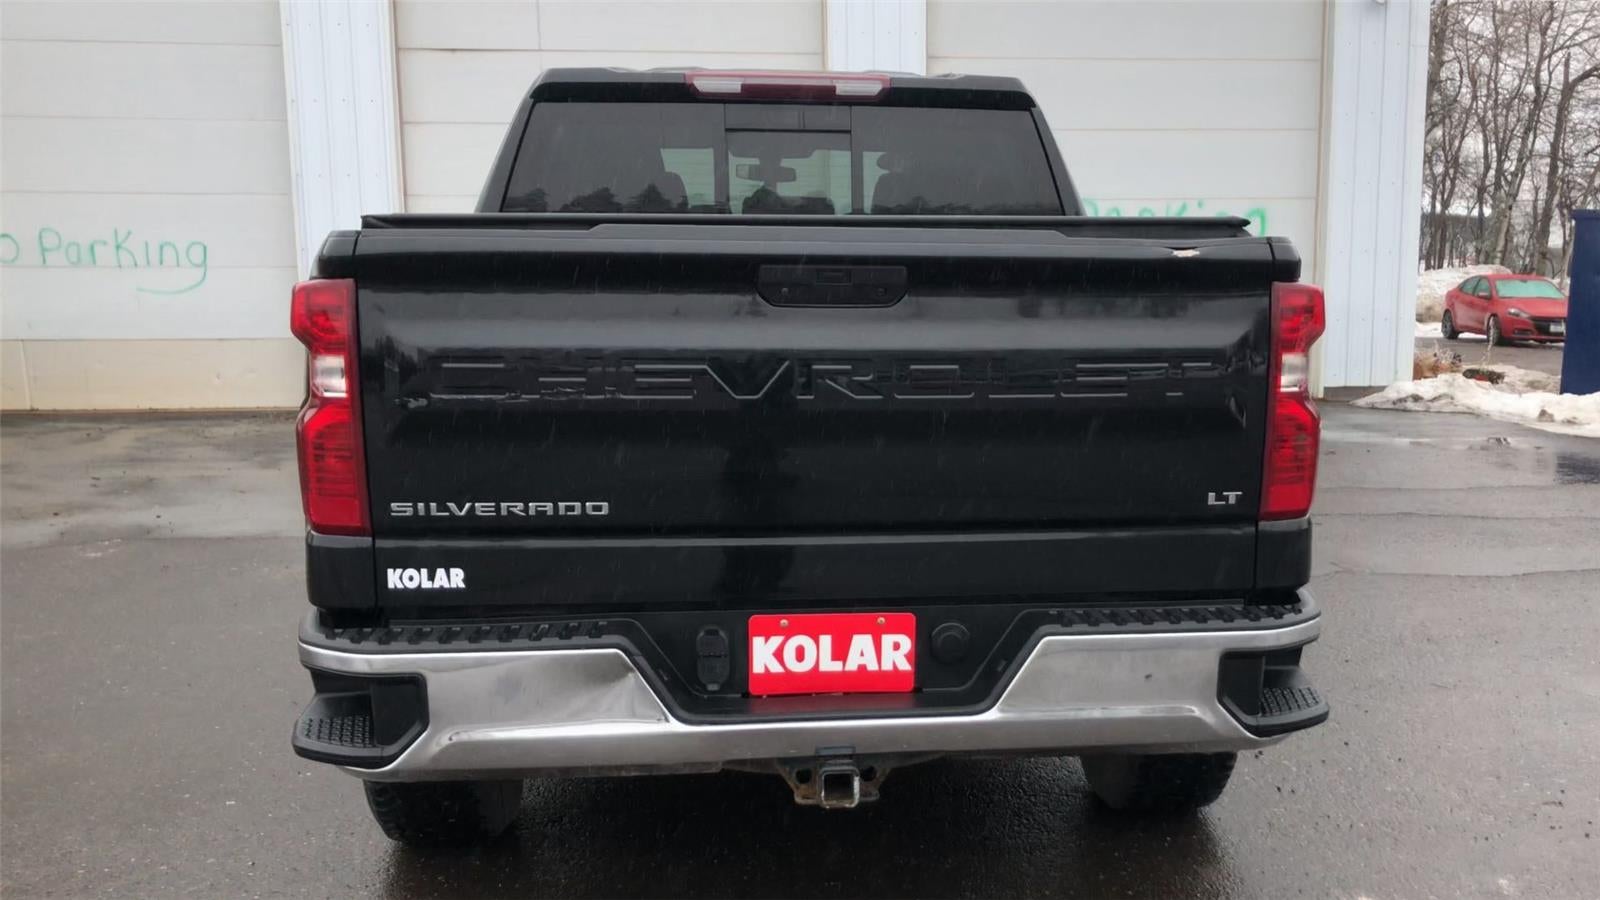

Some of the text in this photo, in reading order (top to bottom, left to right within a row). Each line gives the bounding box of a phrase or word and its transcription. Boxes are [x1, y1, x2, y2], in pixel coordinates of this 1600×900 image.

[429, 360, 1217, 399] CHEVROLET
[390, 501, 610, 517] SILVERADO
[1207, 491, 1243, 506] LT
[386, 567, 466, 590] KOLAR
[752, 634, 912, 674] KOLAR
